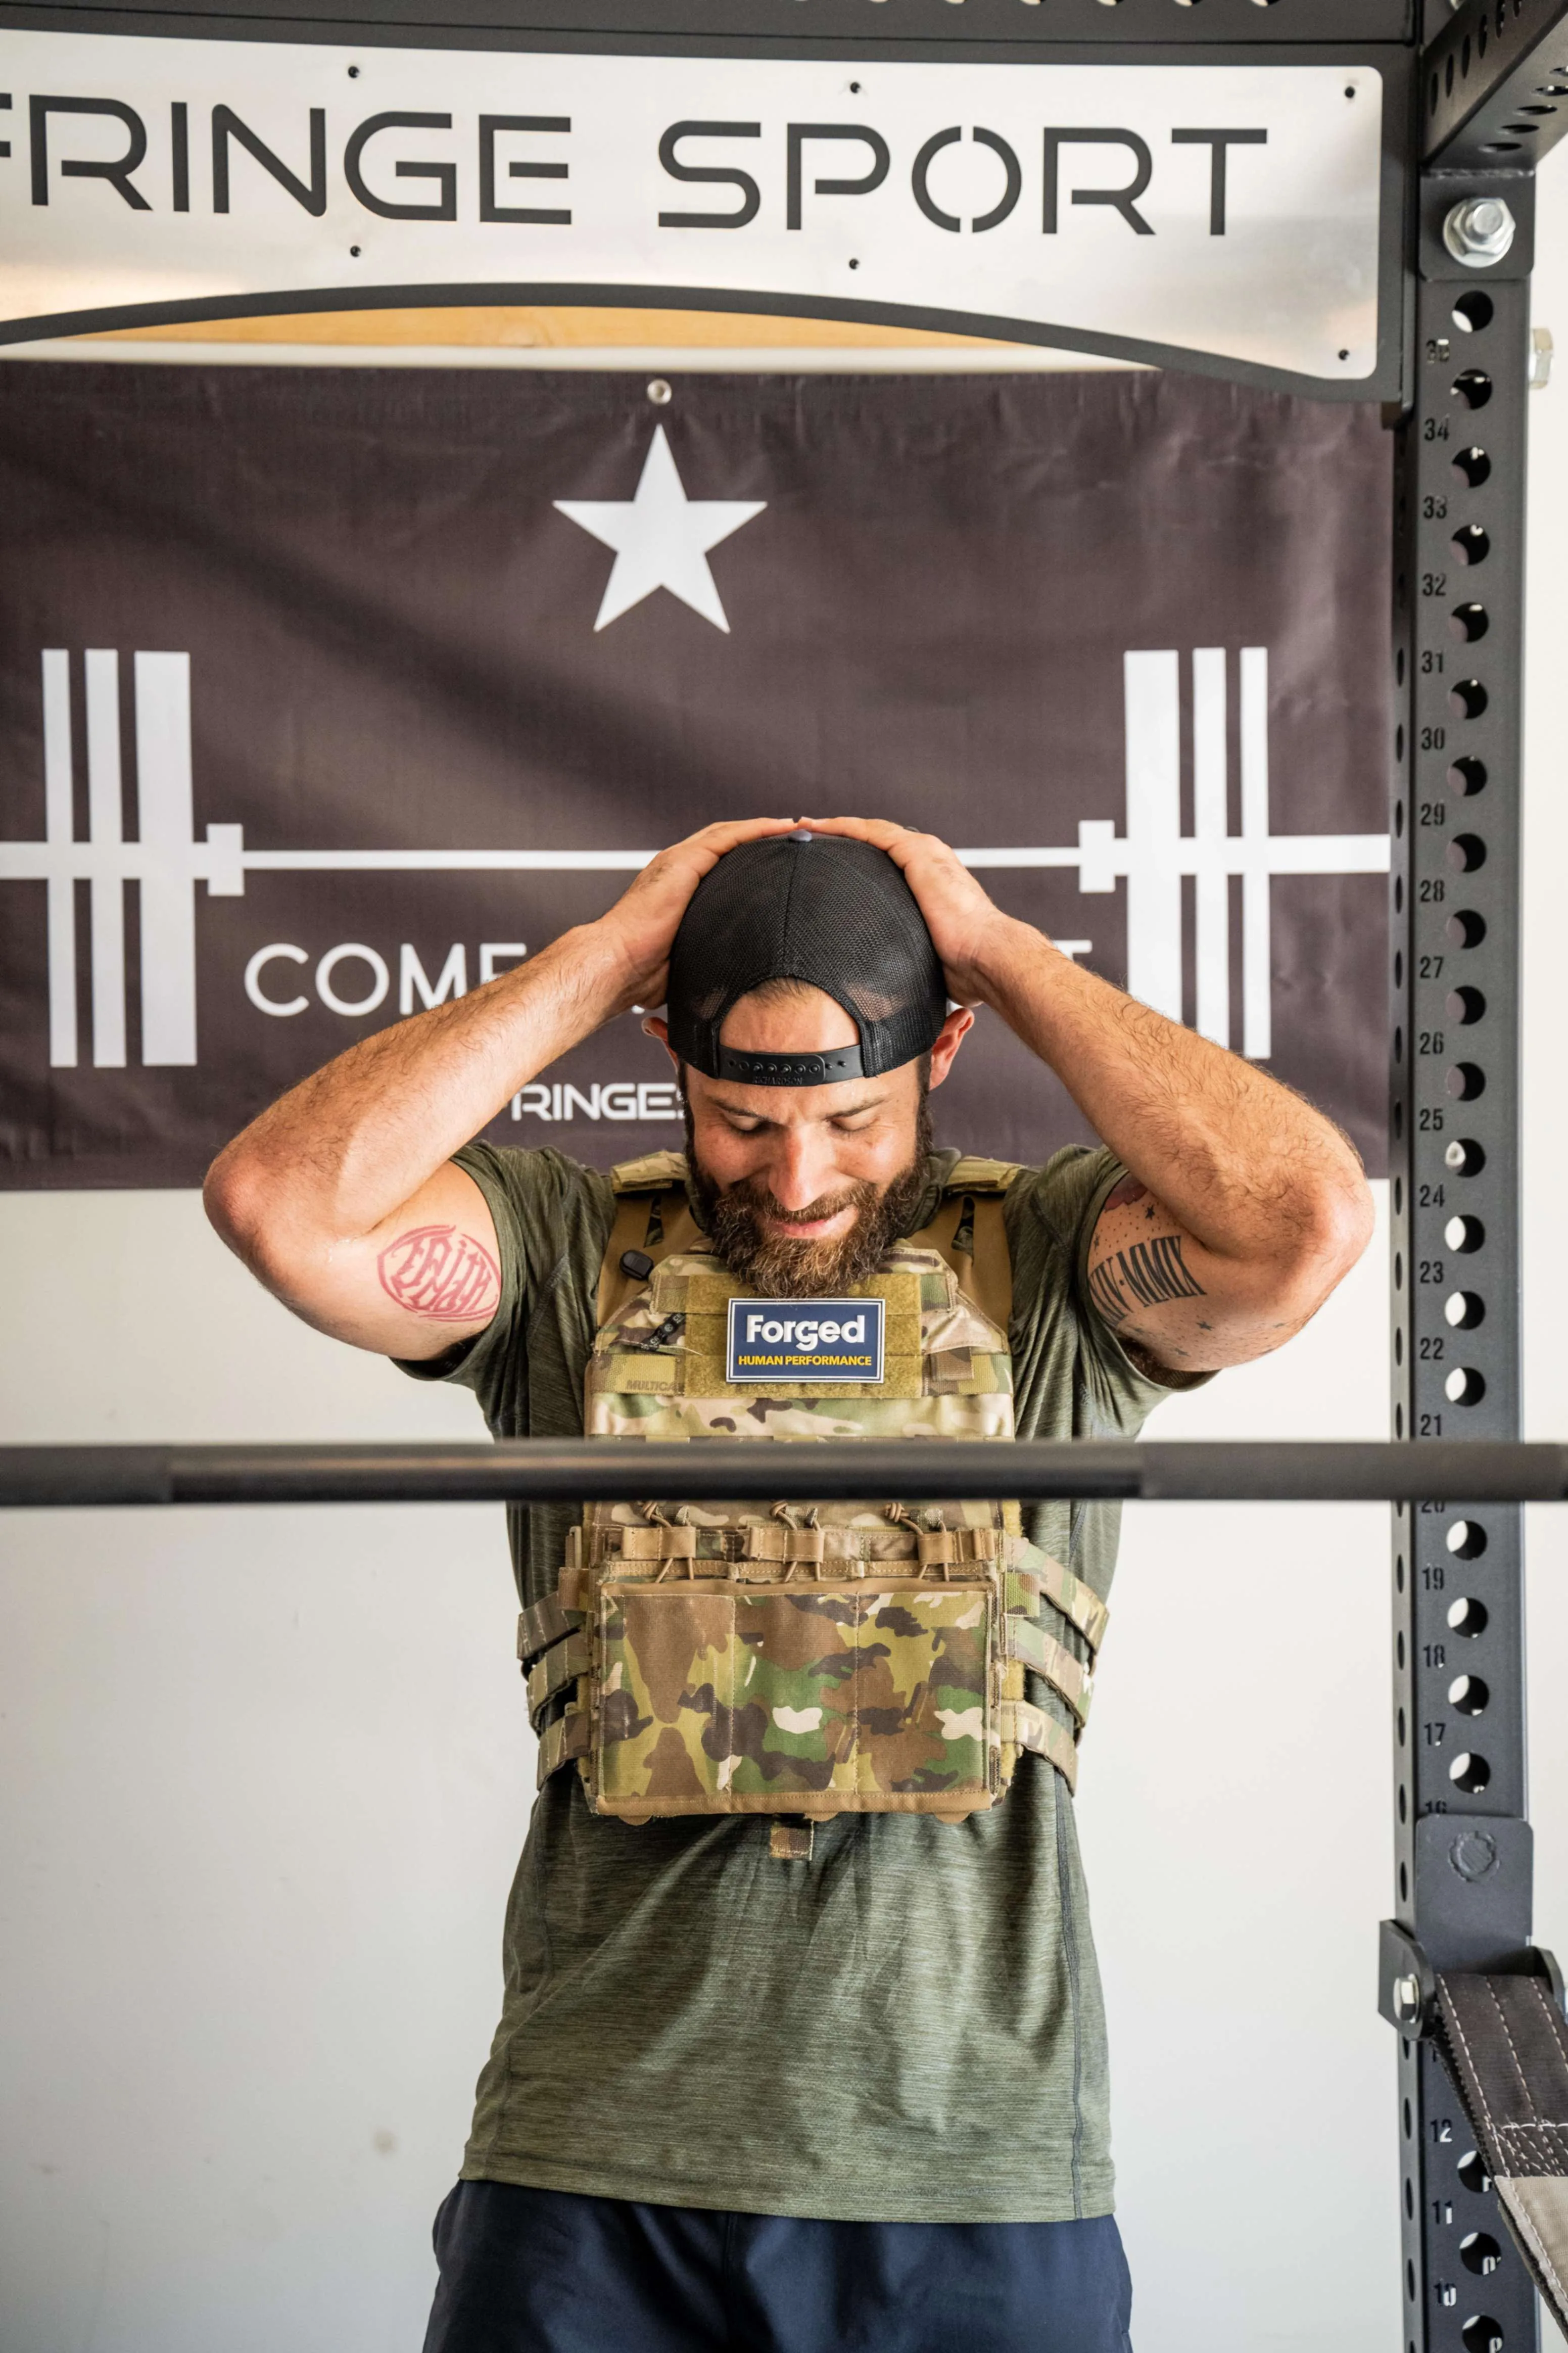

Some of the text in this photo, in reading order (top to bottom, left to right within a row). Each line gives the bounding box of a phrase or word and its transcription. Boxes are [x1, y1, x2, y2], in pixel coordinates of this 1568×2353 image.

[0, 93, 1267, 236] RINGE SPORT
[1424, 415, 1449, 441] 34
[1423, 496, 1447, 519] 33
[1422, 573, 1446, 596] 32
[1421, 651, 1444, 673] 31
[1421, 727, 1445, 750] 30
[1421, 804, 1445, 826] 29
[1420, 880, 1444, 902] 28
[1420, 956, 1444, 978] 27
[1420, 1032, 1444, 1055] 26
[511, 1083, 685, 1121] RINGE
[1420, 1108, 1443, 1131] 25
[1420, 1185, 1445, 1207] 24
[1420, 1261, 1444, 1283] 23
[746, 1314, 865, 1351] Forged
[1420, 1337, 1444, 1359] 22
[738, 1355, 872, 1366] HUMAN PERFORMANCE
[1420, 1414, 1442, 1436] 21
[1422, 1567, 1445, 1590] 19
[1423, 1645, 1445, 1667] 18
[1424, 1723, 1446, 1746] 17
[1430, 2119, 1452, 2143] 12
[1432, 2200, 1452, 2224] 11
